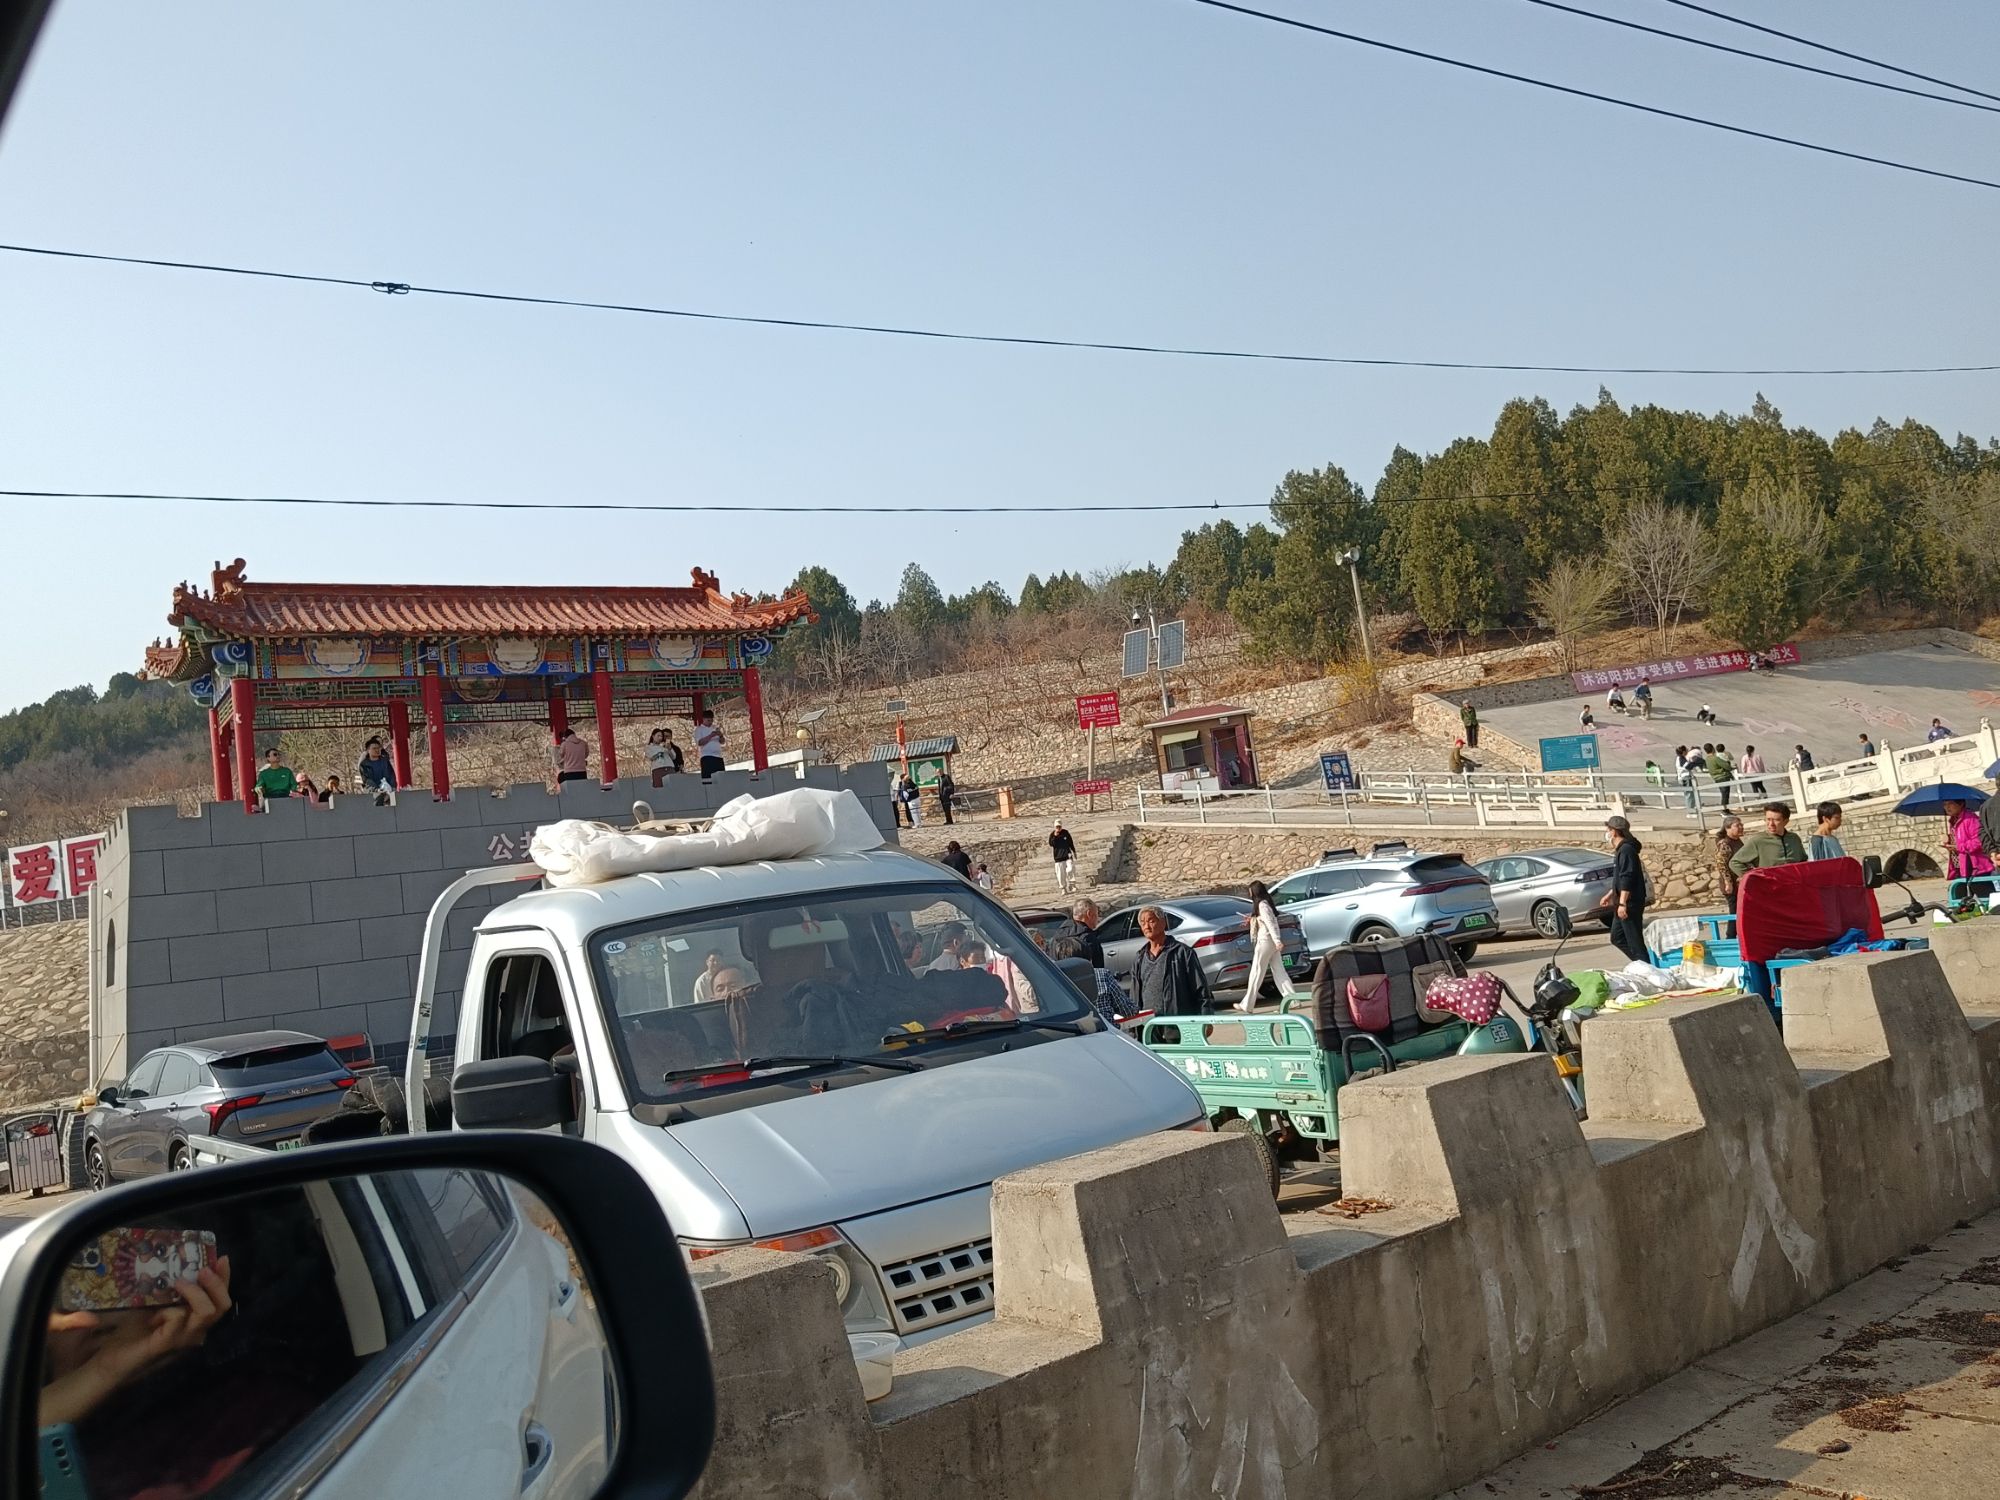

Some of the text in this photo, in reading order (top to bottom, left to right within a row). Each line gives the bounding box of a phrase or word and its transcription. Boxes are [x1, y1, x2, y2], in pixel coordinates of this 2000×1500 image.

[1581, 646, 1794, 687] 沐浴阳光享受绿色 走进森林防火
[12, 839, 102, 903] 爱国
